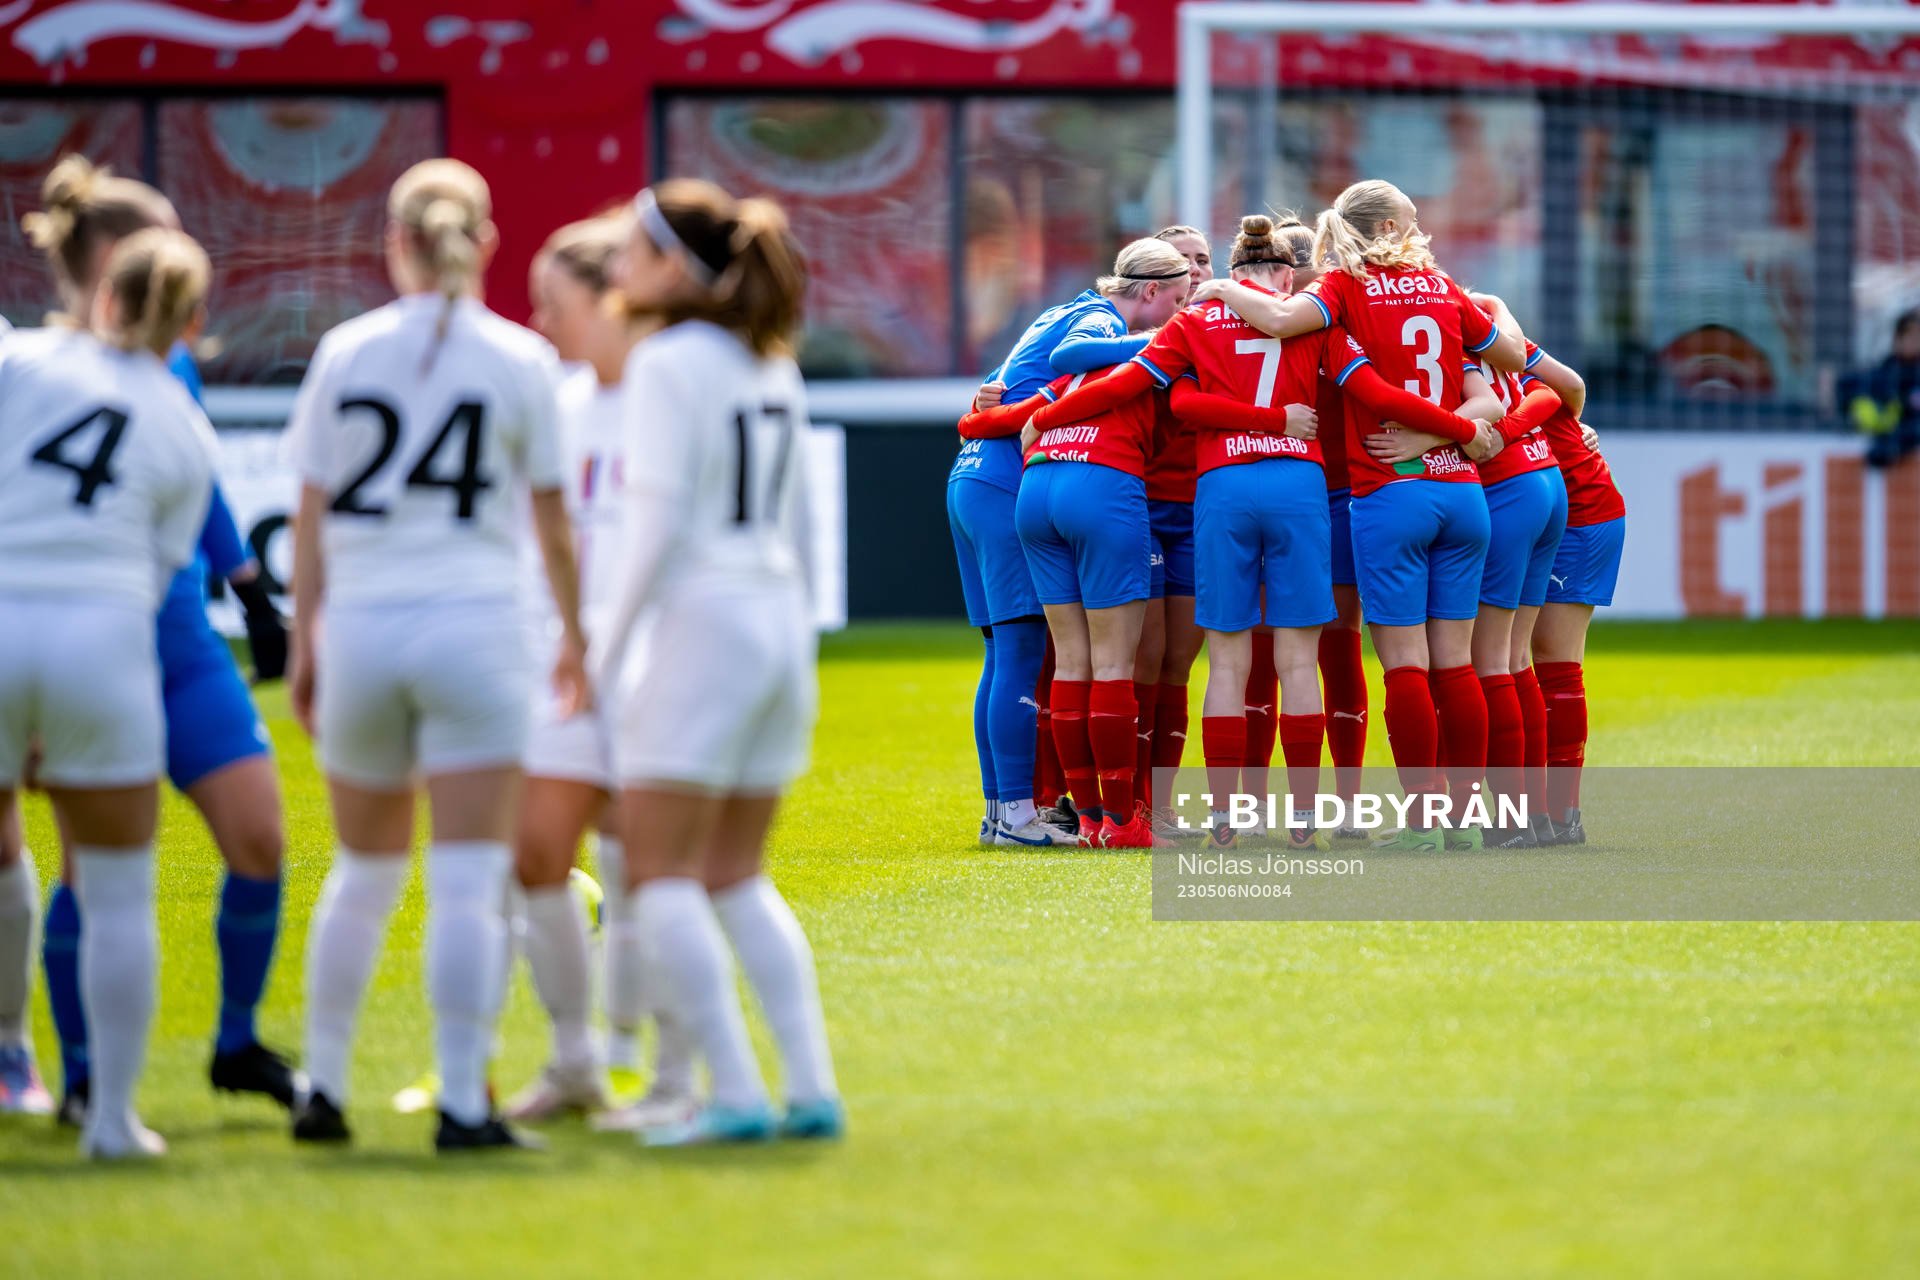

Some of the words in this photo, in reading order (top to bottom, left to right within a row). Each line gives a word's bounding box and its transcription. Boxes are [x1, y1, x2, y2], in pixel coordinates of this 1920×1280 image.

[1205, 303, 1241, 322] ak
[1365, 272, 1431, 296] akea
[1235, 338, 1282, 434] 7
[1400, 315, 1444, 406] 3
[29, 406, 130, 507] 4
[329, 397, 493, 520] 24
[731, 403, 793, 525] 17
[1039, 425, 1099, 447] WINROTH
[1225, 435, 1308, 458] RAHMBERG
[1421, 448, 1460, 467] Solid
[1678, 454, 1920, 618] till
